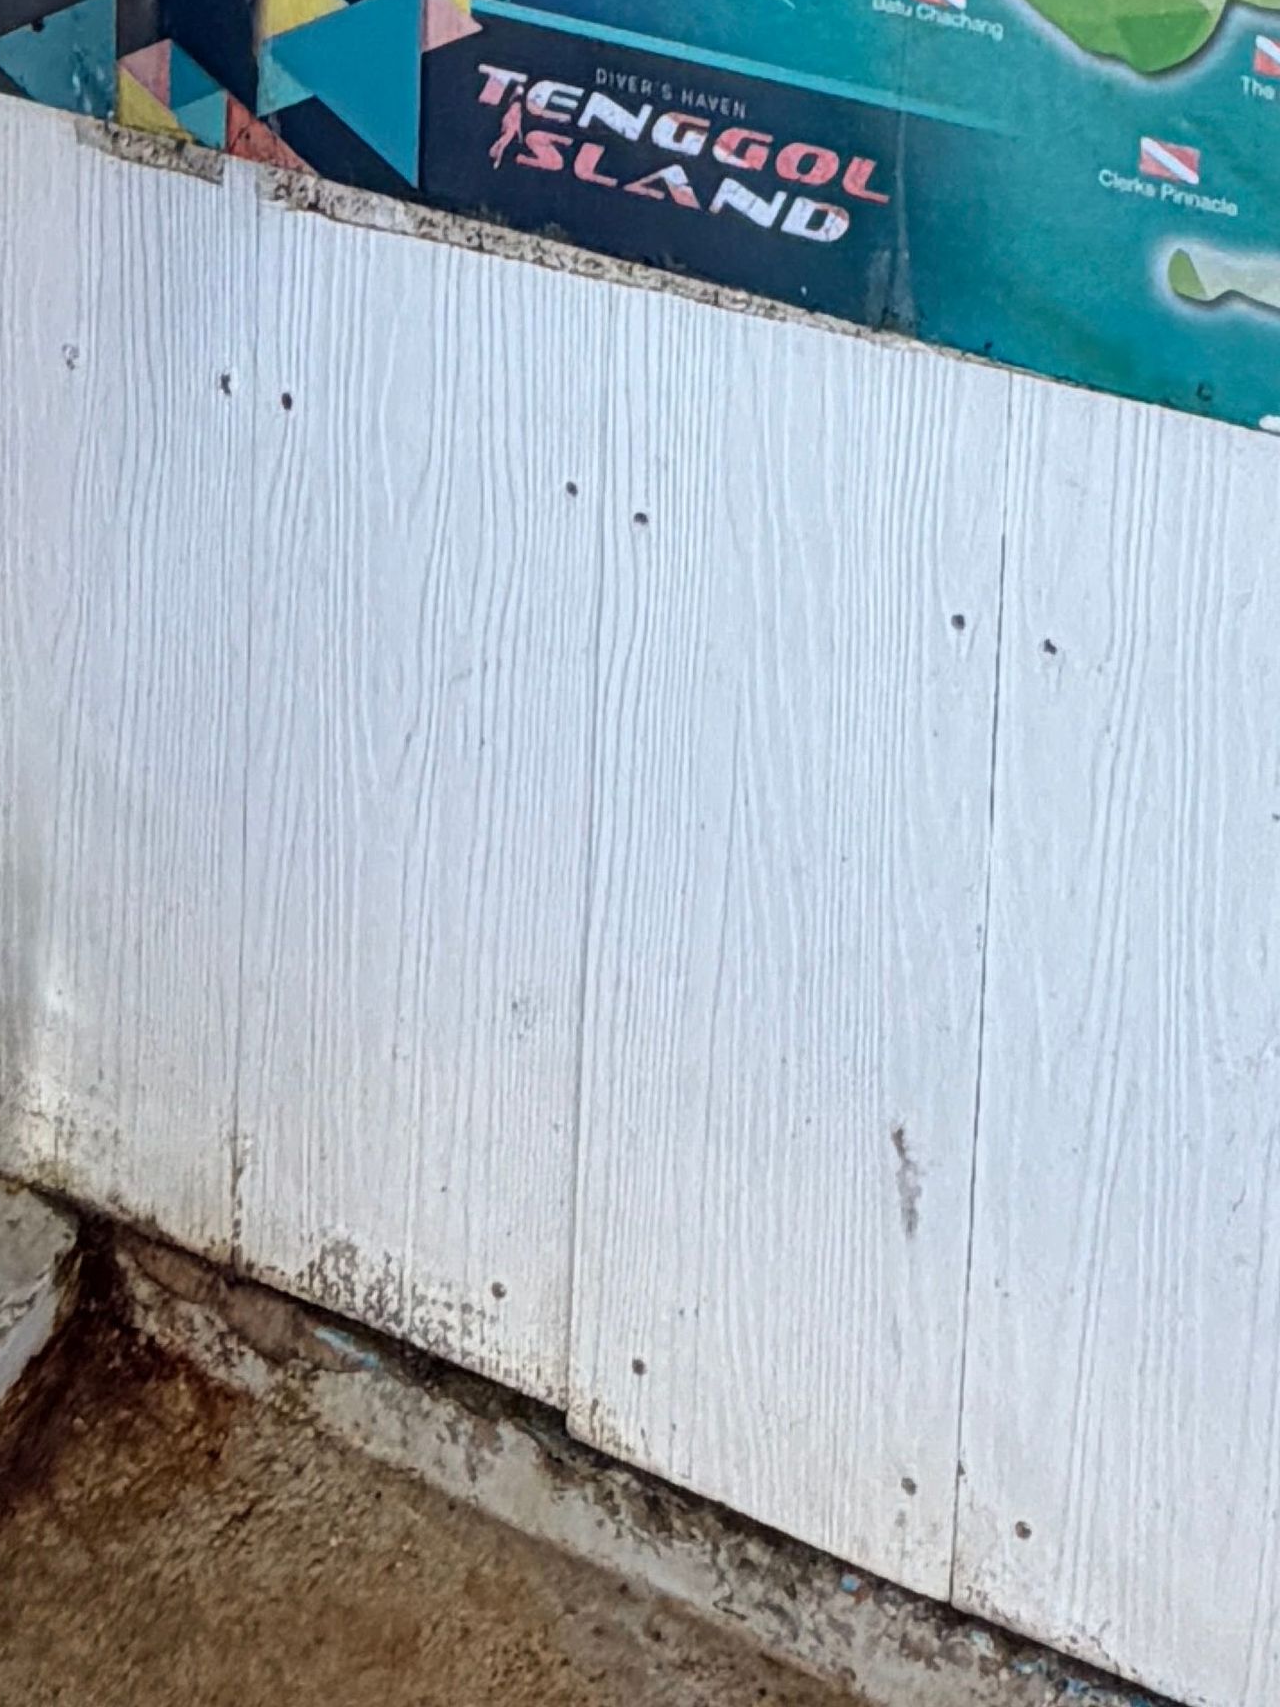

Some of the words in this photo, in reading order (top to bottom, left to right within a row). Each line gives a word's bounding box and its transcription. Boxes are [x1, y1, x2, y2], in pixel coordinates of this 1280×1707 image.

[595, 67, 673, 102] DIVER'S
[681, 88, 747, 120] HAVEN
[1240, 74, 1276, 101] The
[477, 62, 891, 205] TENGGOL
[488, 102, 851, 243] ISLAND
[1160, 182, 1239, 218] Pinnacle
